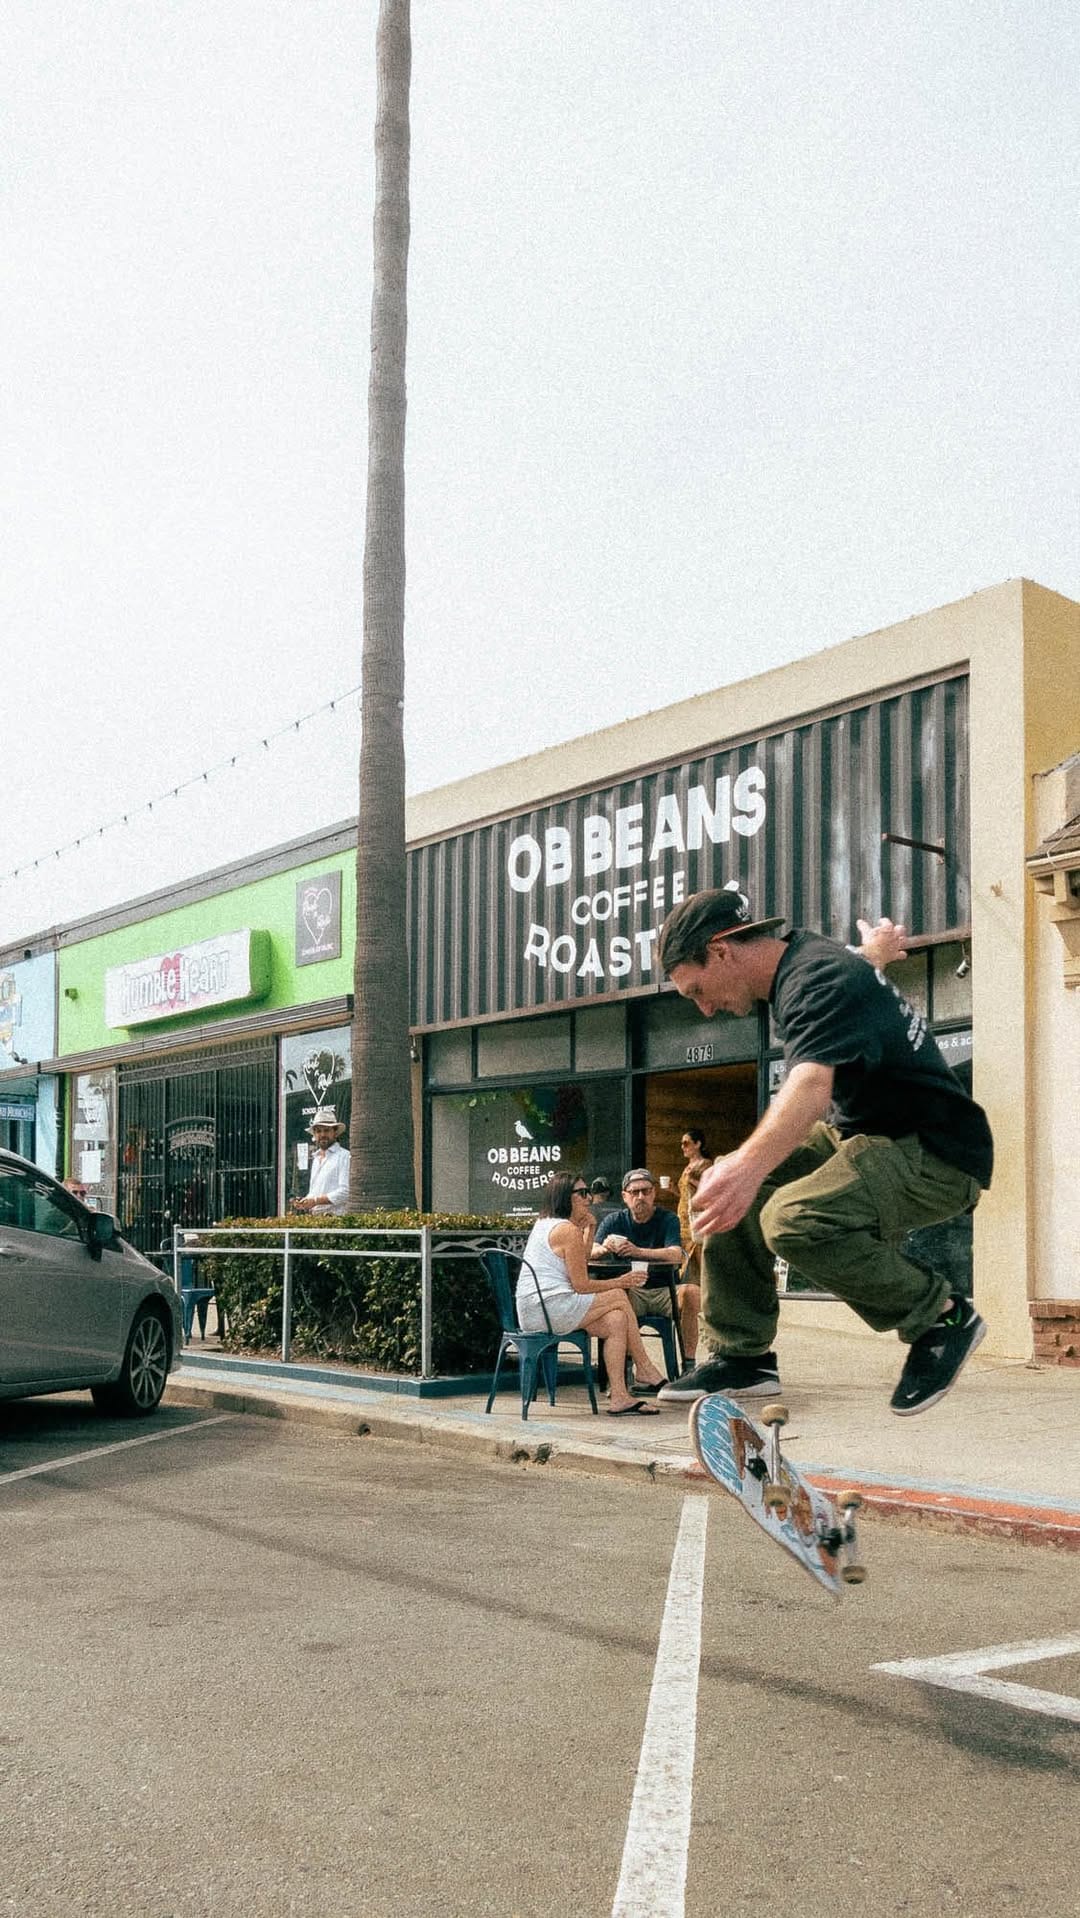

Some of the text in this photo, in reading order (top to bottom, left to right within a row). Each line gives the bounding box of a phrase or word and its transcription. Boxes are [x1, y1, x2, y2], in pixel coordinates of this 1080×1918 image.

[507, 766, 766, 893] OB BEANS
[571, 871, 685, 925] COFFEE
[687, 1045, 713, 1062] 4879
[509, 1145, 561, 1163] BEANS
[507, 1165, 541, 1175] COFFEE
